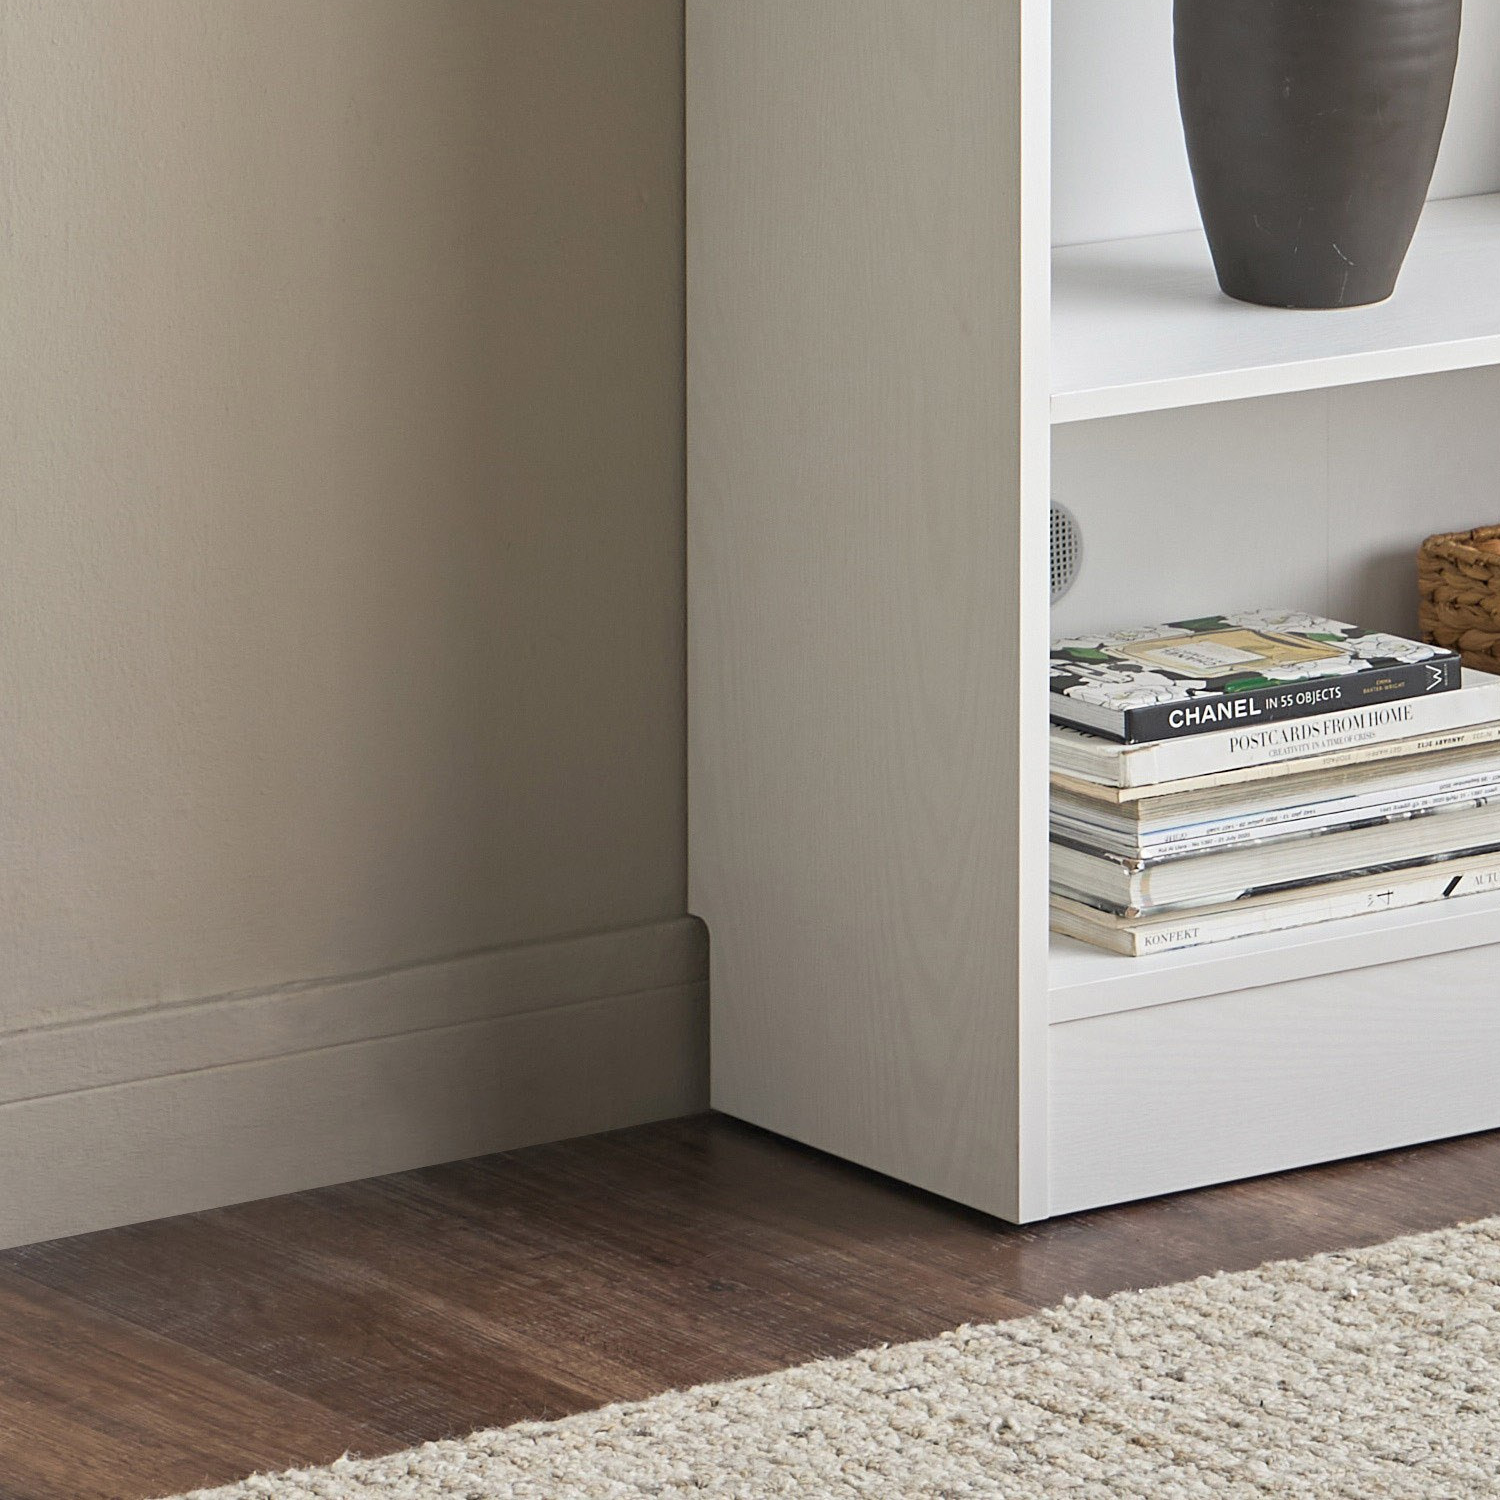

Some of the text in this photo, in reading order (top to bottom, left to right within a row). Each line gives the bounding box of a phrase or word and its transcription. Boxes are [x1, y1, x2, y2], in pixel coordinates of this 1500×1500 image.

[1168, 686, 1342, 728] CHANEL IN 55 OBJECTS
[1229, 704, 1414, 753] POSTCARDS FROM HOME
[1269, 743, 1311, 758] CREATIVITY
[1327, 737, 1344, 747] TIME
[1435, 736, 1465, 746] JANUARY
[1144, 928, 1200, 946] KONFEKT
